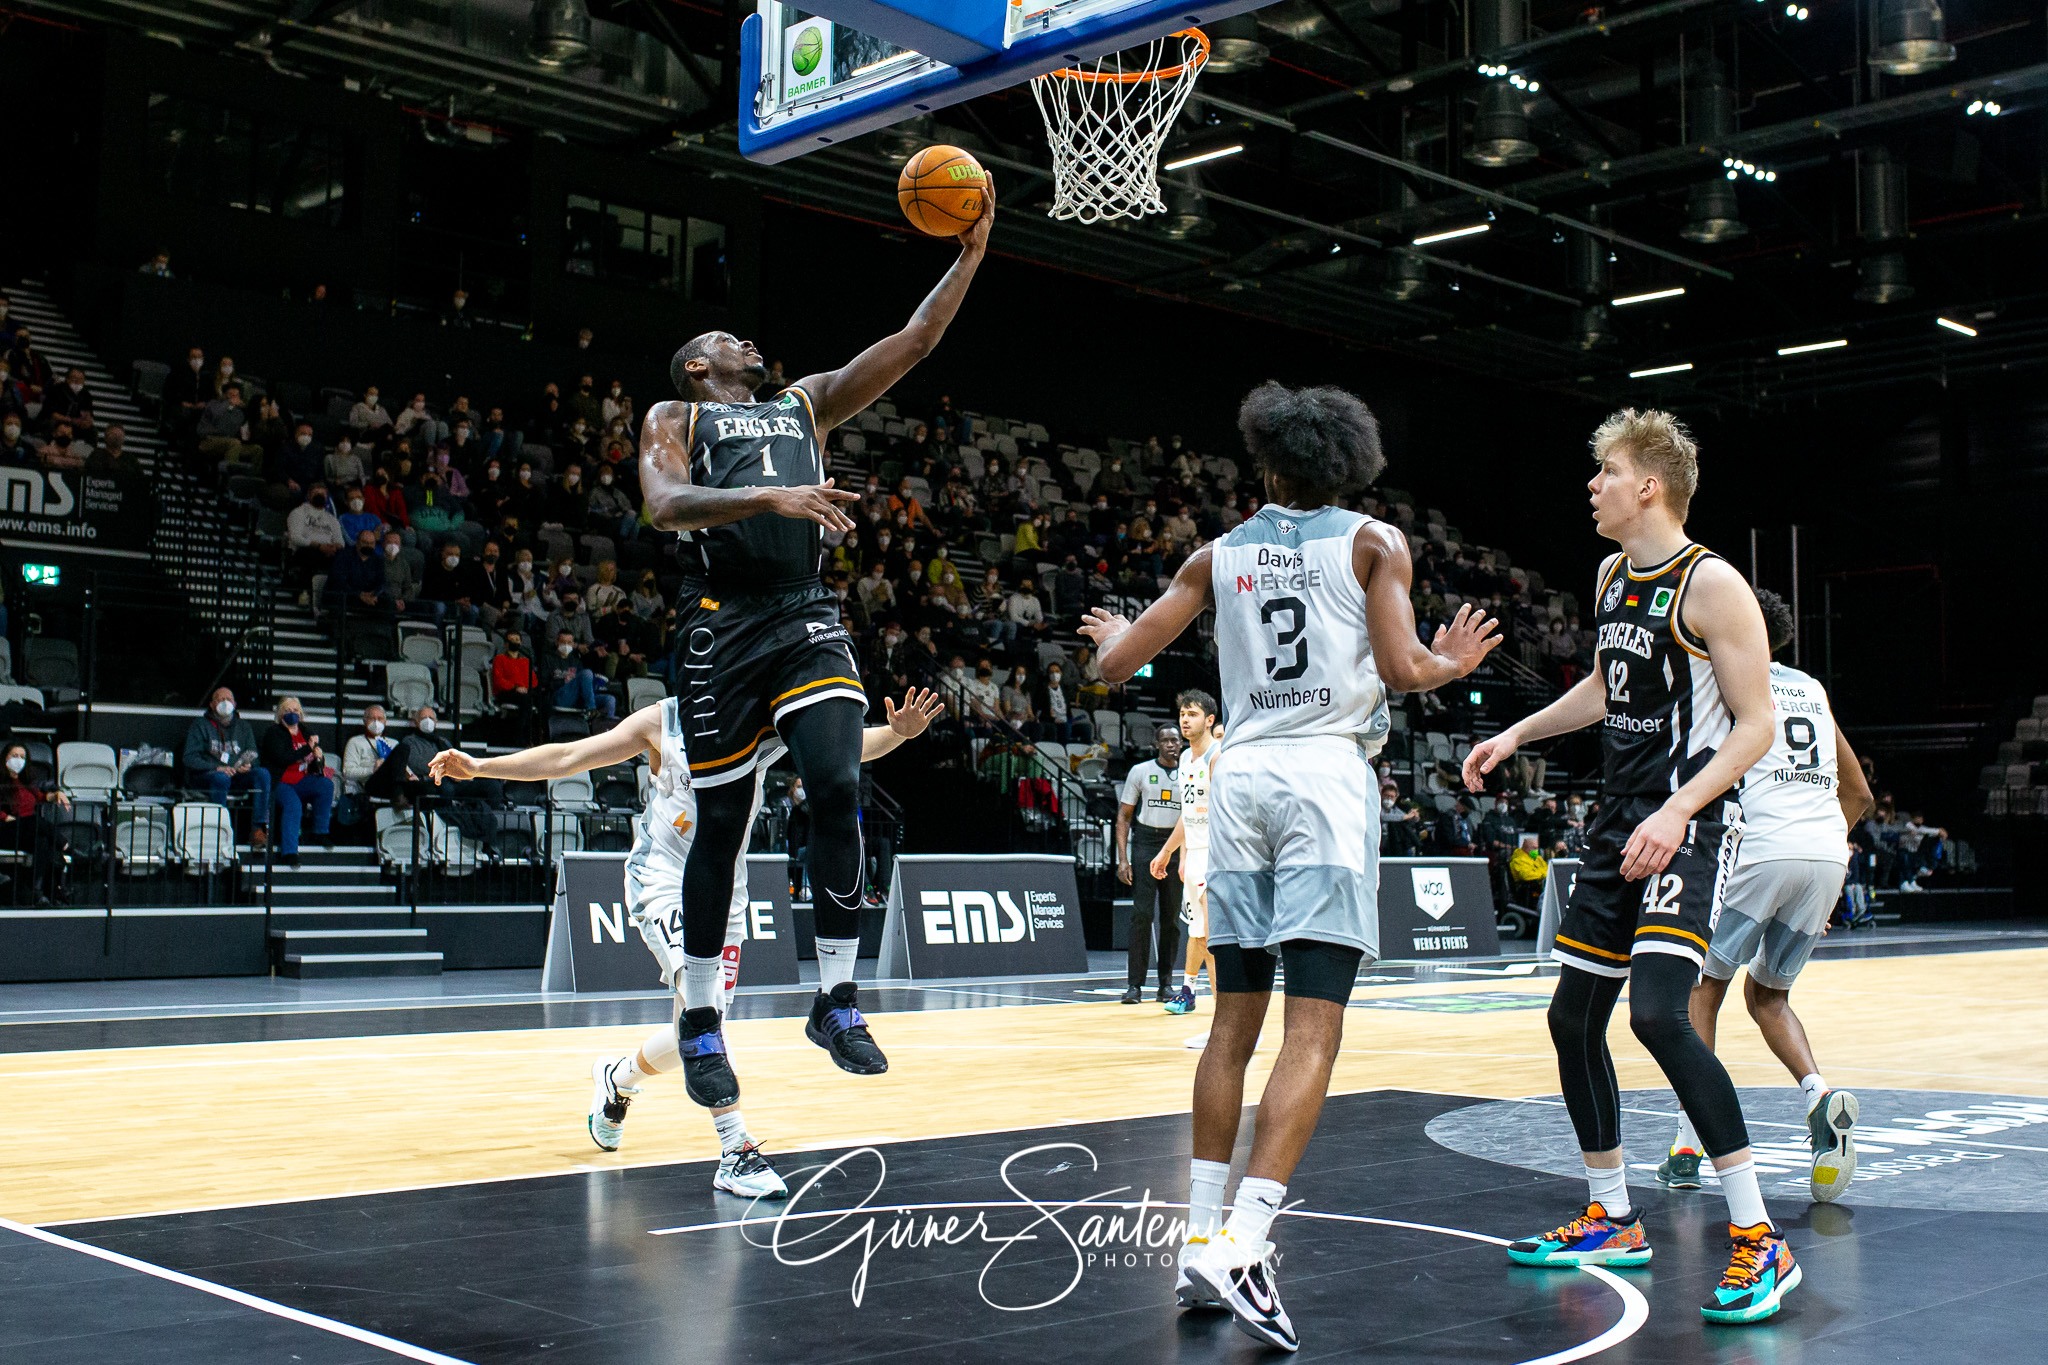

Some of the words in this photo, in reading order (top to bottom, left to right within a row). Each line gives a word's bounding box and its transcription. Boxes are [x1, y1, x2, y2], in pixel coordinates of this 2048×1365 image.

[787, 76, 826, 98] BARMER
[961, 198, 983, 211] EV
[715, 416, 804, 441] EAGLES
[760, 443, 778, 477] 1
[86, 477, 115, 488] Experts
[86, 487, 122, 501] Managed
[85, 499, 119, 512] Services
[1257, 548, 1303, 569] Davis
[1261, 597, 1308, 682] 3
[1598, 622, 1655, 660] EAGLES
[1608, 659, 1630, 703] 42
[1772, 685, 1806, 698] Price
[1250, 687, 1331, 710] Nürnberg
[1772, 699, 1823, 715] -ERGIE
[1783, 716, 1820, 772] 9
[1030, 890, 1057, 904] Experts
[1642, 873, 1684, 915] 42
[920, 891, 1026, 944] EMS
[1032, 904, 1065, 917] Managed
[1034, 917, 1064, 929] Services
[1441, 935, 1469, 950] EVENTS
